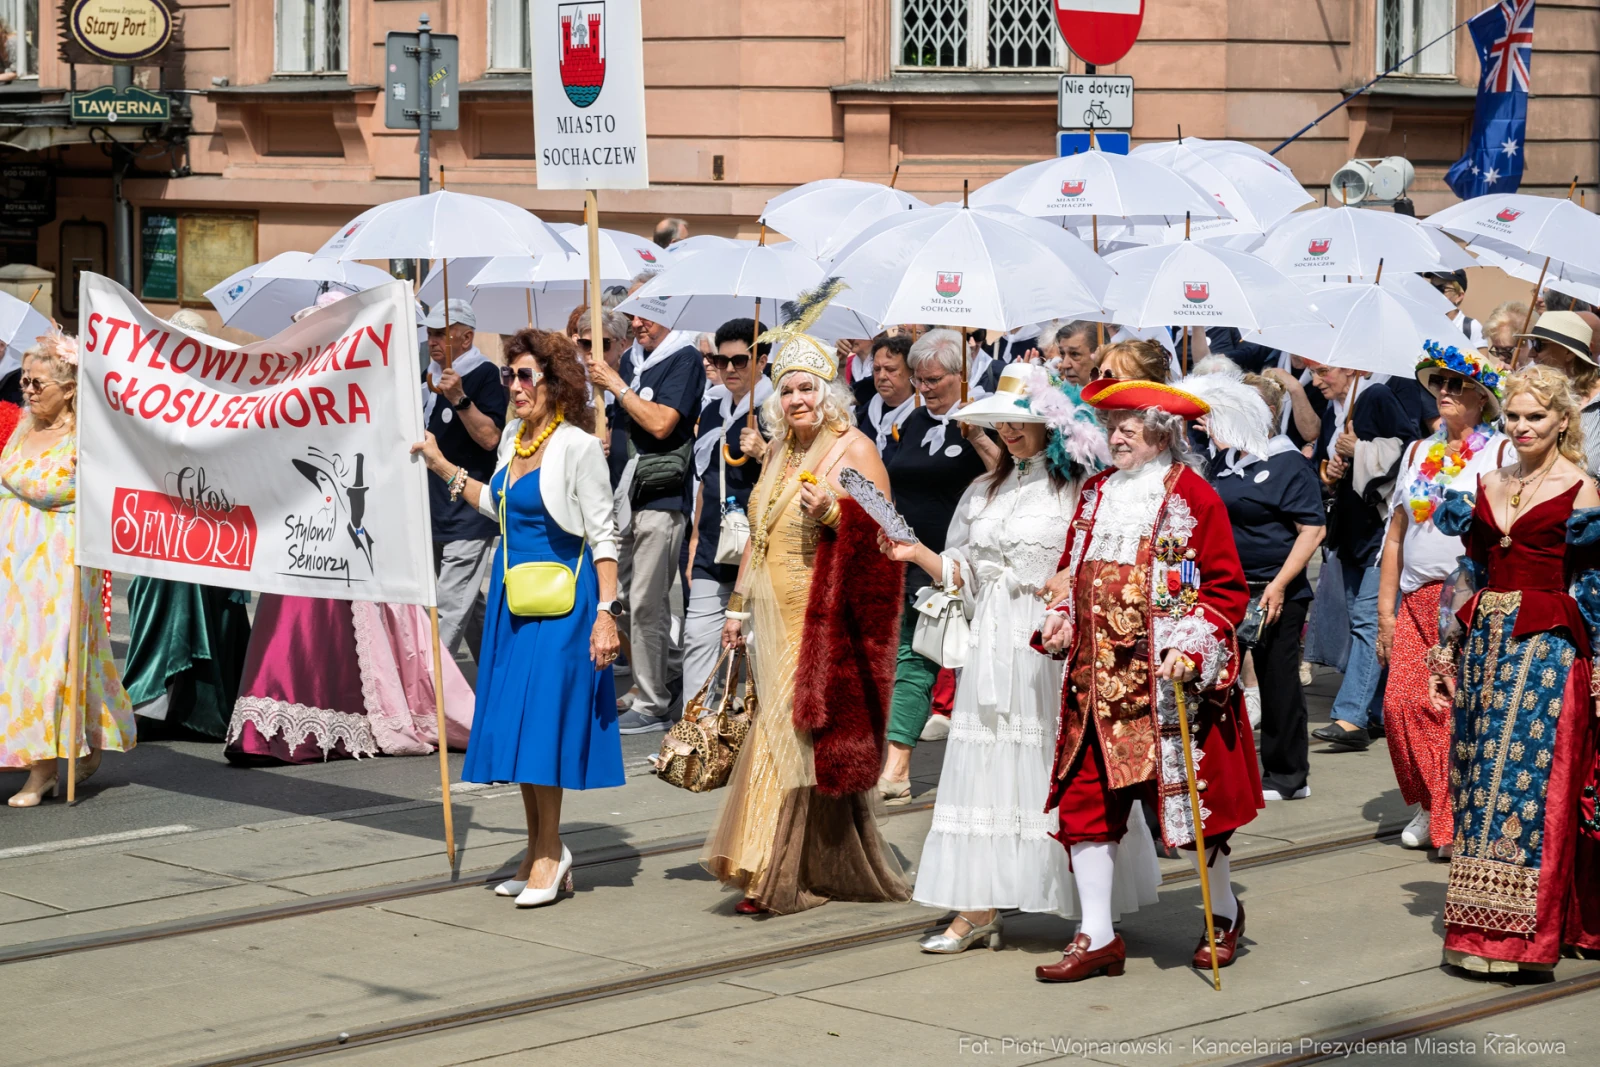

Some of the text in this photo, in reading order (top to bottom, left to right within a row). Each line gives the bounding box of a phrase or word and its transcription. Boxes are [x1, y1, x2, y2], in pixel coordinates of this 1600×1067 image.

[84, 16, 147, 40] Stary Port
[1065, 80, 1131, 98] Nie dotyczy
[78, 100, 163, 114] TAWERNA
[556, 114, 616, 134] MIASTO
[543, 147, 637, 166] SOCHACZEW
[920, 305, 972, 313] SOCHACZEW
[85, 312, 393, 386] STYLOWI SENIORZY
[103, 370, 371, 429] GŁOSU SENIORA
[166, 466, 236, 522] Głos
[284, 513, 334, 555] Stylowi
[288, 543, 350, 587] Seniorzy
